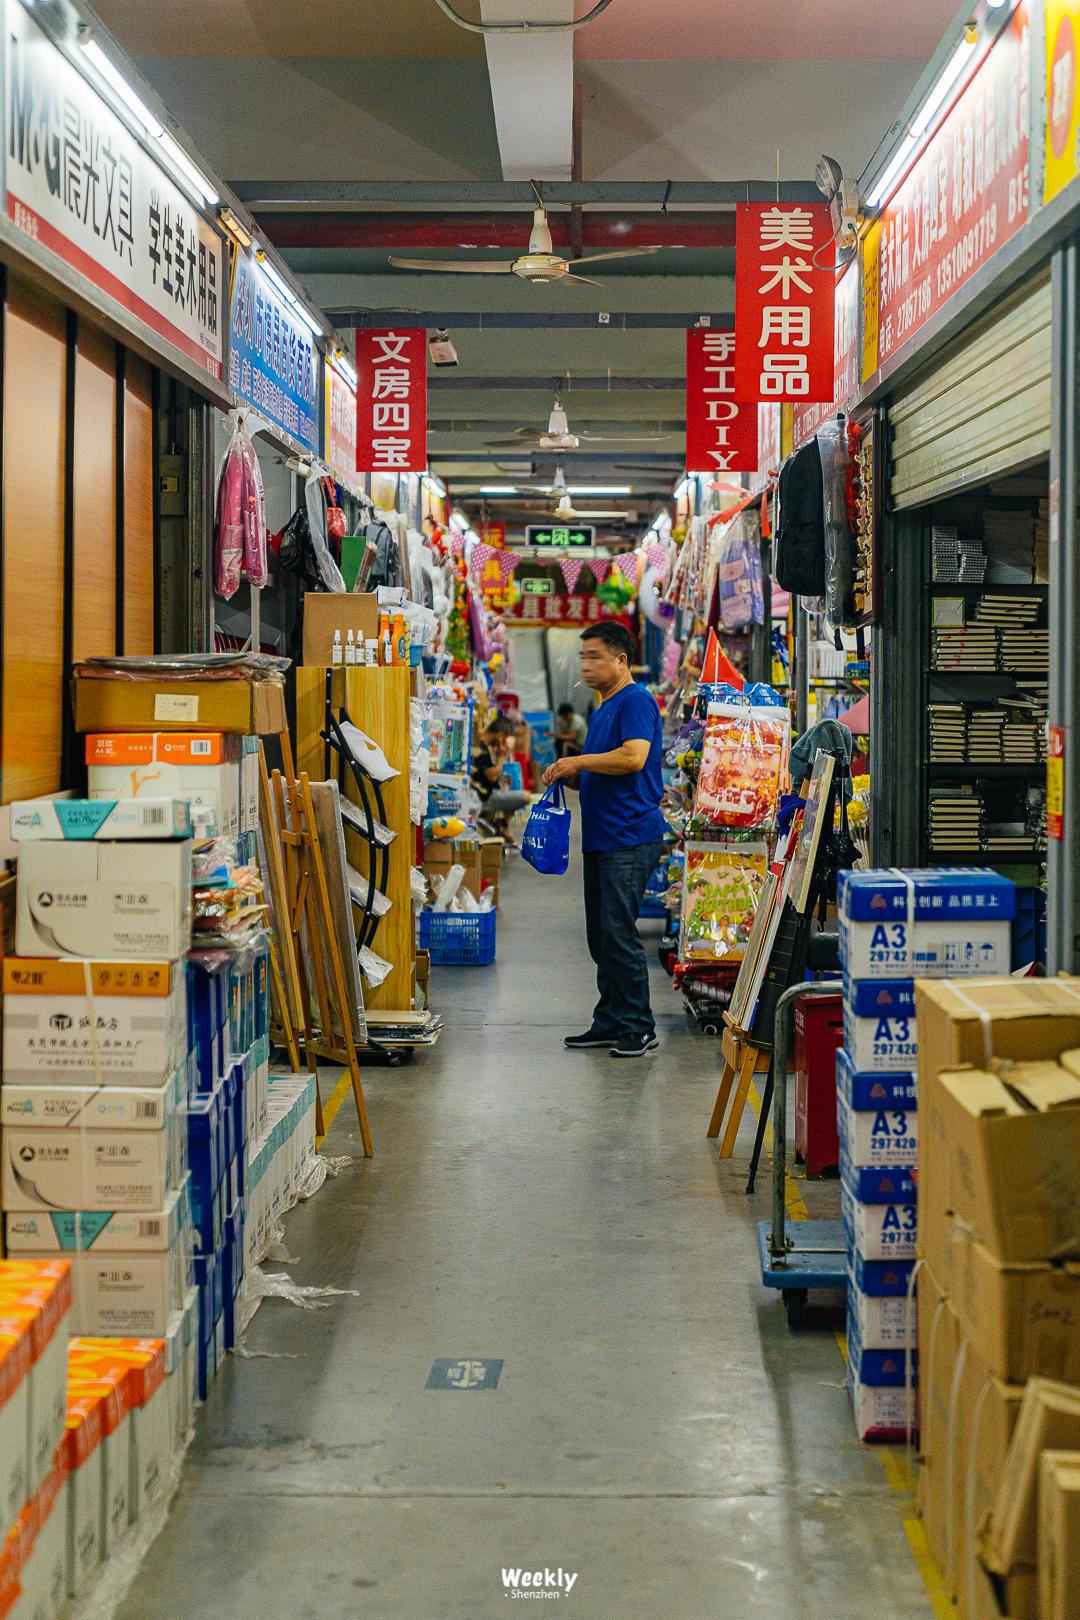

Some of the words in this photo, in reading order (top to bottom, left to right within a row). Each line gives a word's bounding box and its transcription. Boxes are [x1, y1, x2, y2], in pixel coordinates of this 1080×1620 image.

[148, 186, 217, 337] 学生美术用品
[936, 202, 997, 297] 13510091719
[758, 207, 814, 396] 美术用品
[371, 331, 411, 468] 文房四宝
[949, 894, 999, 907] 品质至上
[870, 924, 906, 949] A3
[874, 1018, 910, 1042] A3
[871, 1111, 908, 1136] A3
[882, 1206, 917, 1230] A3
